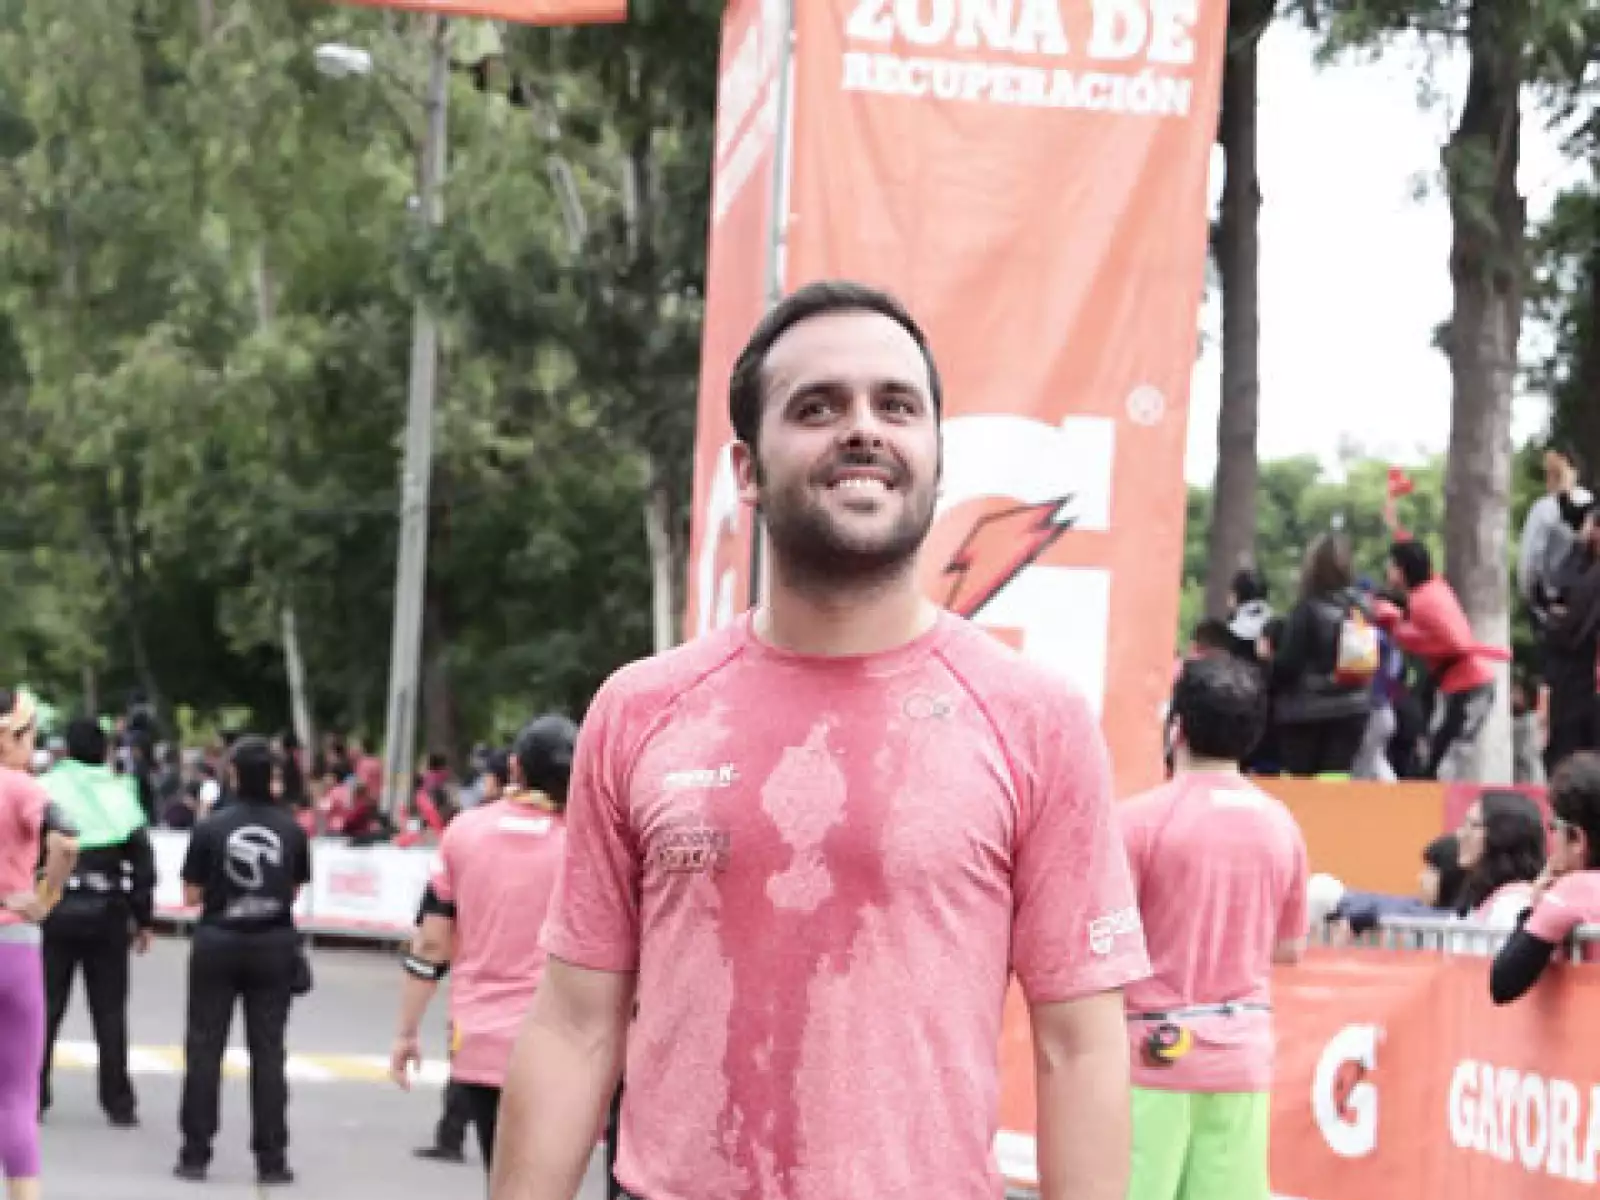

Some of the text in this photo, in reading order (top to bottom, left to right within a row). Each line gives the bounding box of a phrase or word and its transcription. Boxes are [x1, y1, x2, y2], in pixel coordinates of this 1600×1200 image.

[845, 0, 1195, 64] ZONA DE
[842, 51, 1191, 117] RECUPERACIÓN
[1312, 1022, 1379, 1158] G
